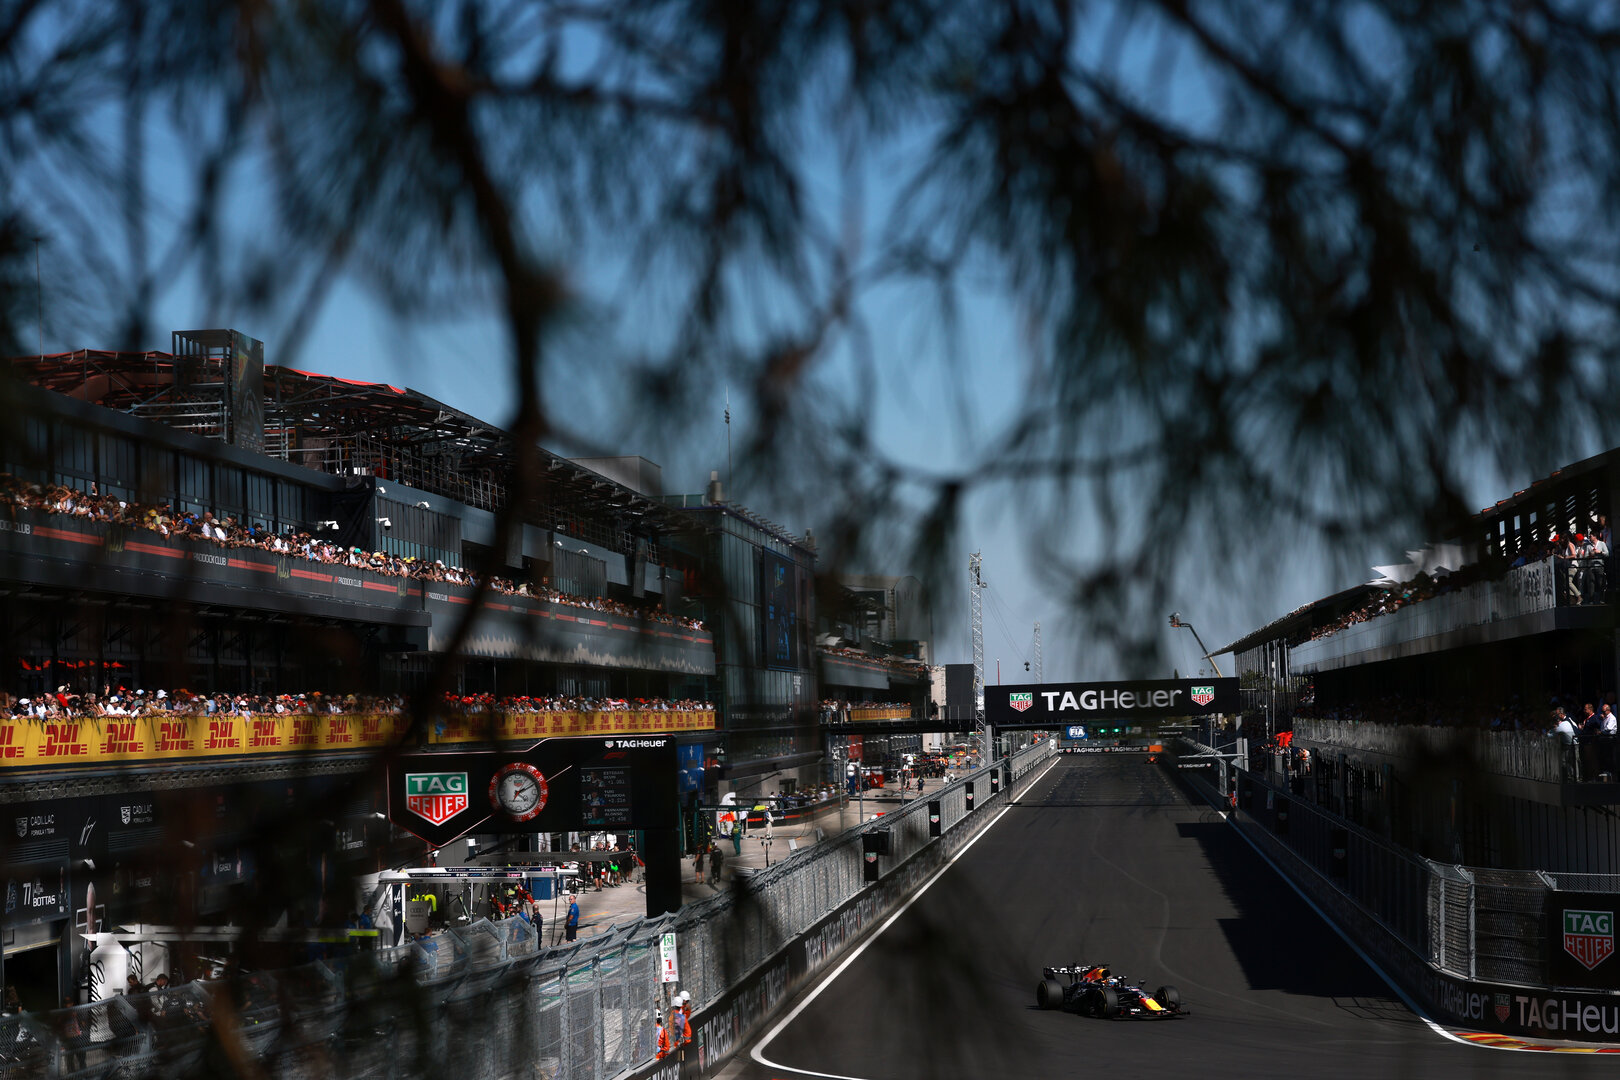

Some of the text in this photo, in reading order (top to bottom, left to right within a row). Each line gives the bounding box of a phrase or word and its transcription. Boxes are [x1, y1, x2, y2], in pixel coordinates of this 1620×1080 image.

[46, 725, 82, 757] DHL
[107, 724, 138, 754] DHL
[160, 723, 188, 750] DHL
[209, 721, 235, 749] DHL
[253, 721, 277, 746] DHL
[293, 721, 315, 745] DHL
[330, 720, 348, 743] DHL
[411, 776, 463, 793] TAG
[581, 775, 592, 783] 13
[410, 796, 464, 822] HEUER
[581, 793, 592, 801] 14
[30, 814, 55, 827] CADILLAC
[582, 812, 593, 820] 15
[23, 882, 32, 906] 77
[33, 894, 56, 908] BOTTAS
[1567, 913, 1609, 933] TAG
[1566, 936, 1611, 965] HEUER
